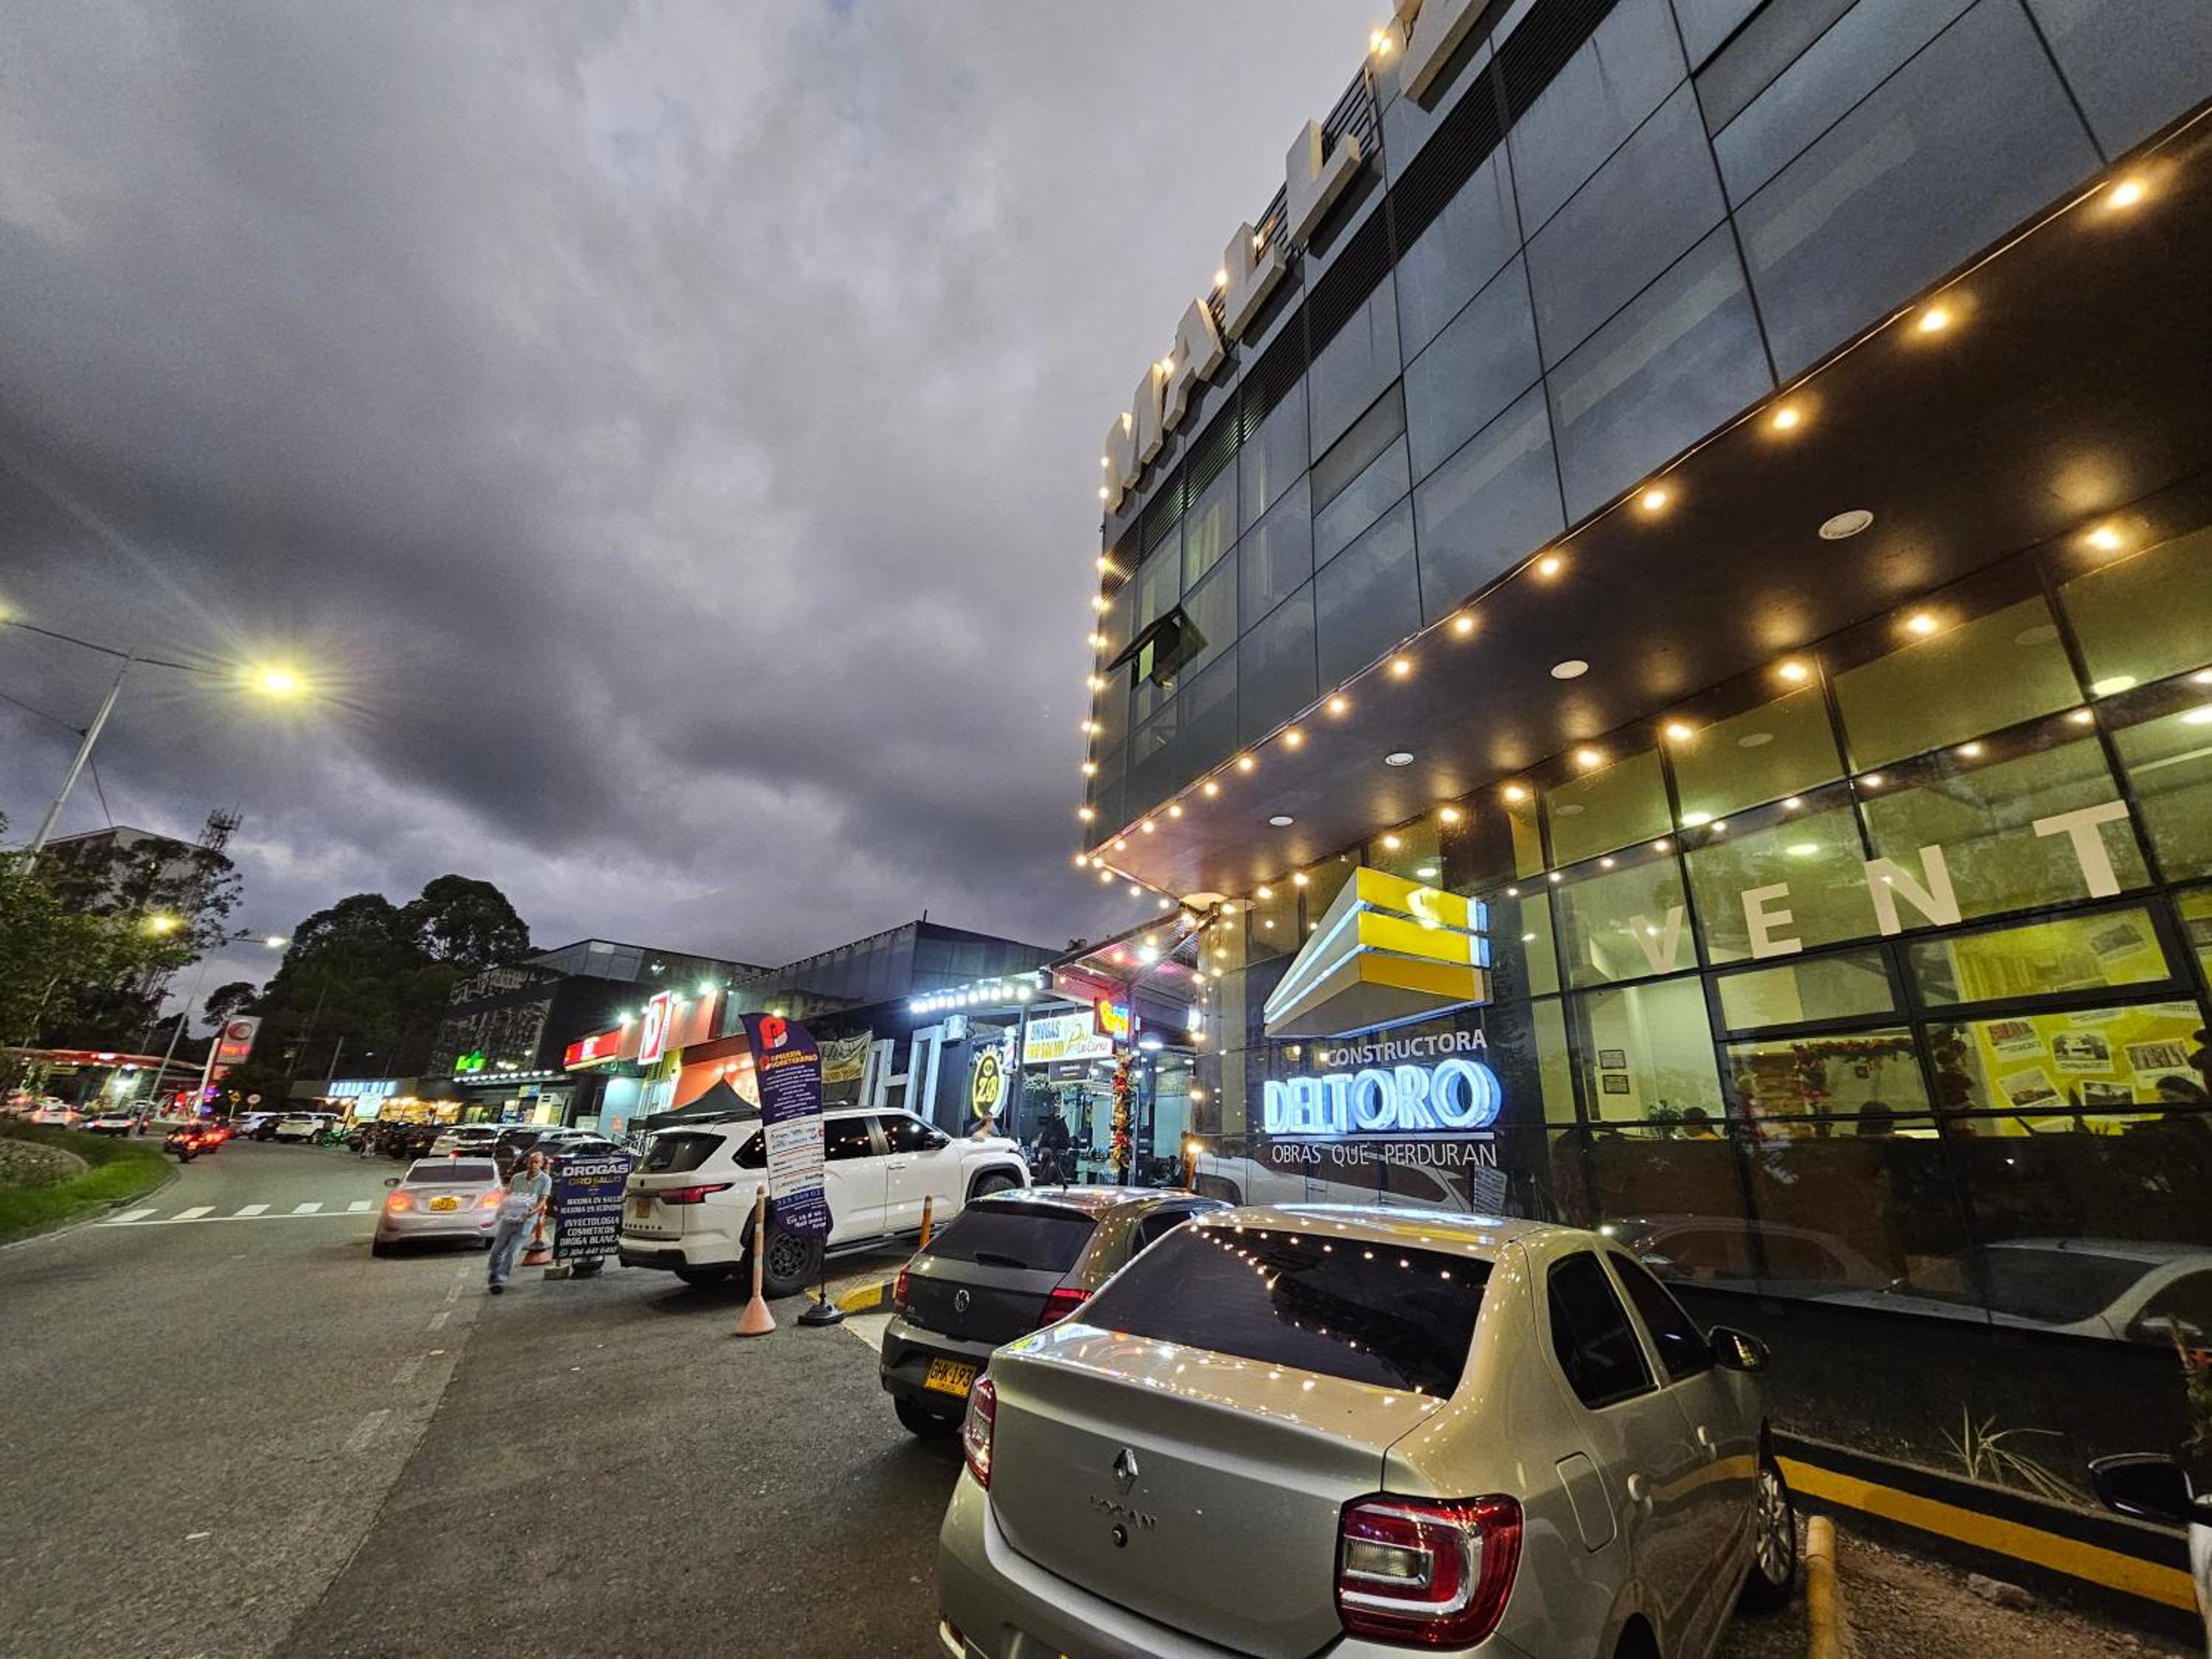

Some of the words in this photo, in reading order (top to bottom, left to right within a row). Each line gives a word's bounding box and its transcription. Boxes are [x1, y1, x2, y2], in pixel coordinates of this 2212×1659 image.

[1327, 1029, 1487, 1067] CONSTRUCTORA
[1272, 1144, 1321, 1164] OBRAS
[1332, 1145, 1369, 1166] QUE
[1385, 1144, 1498, 1168] PERDURAN
[562, 1164, 629, 1177] DROGAS
